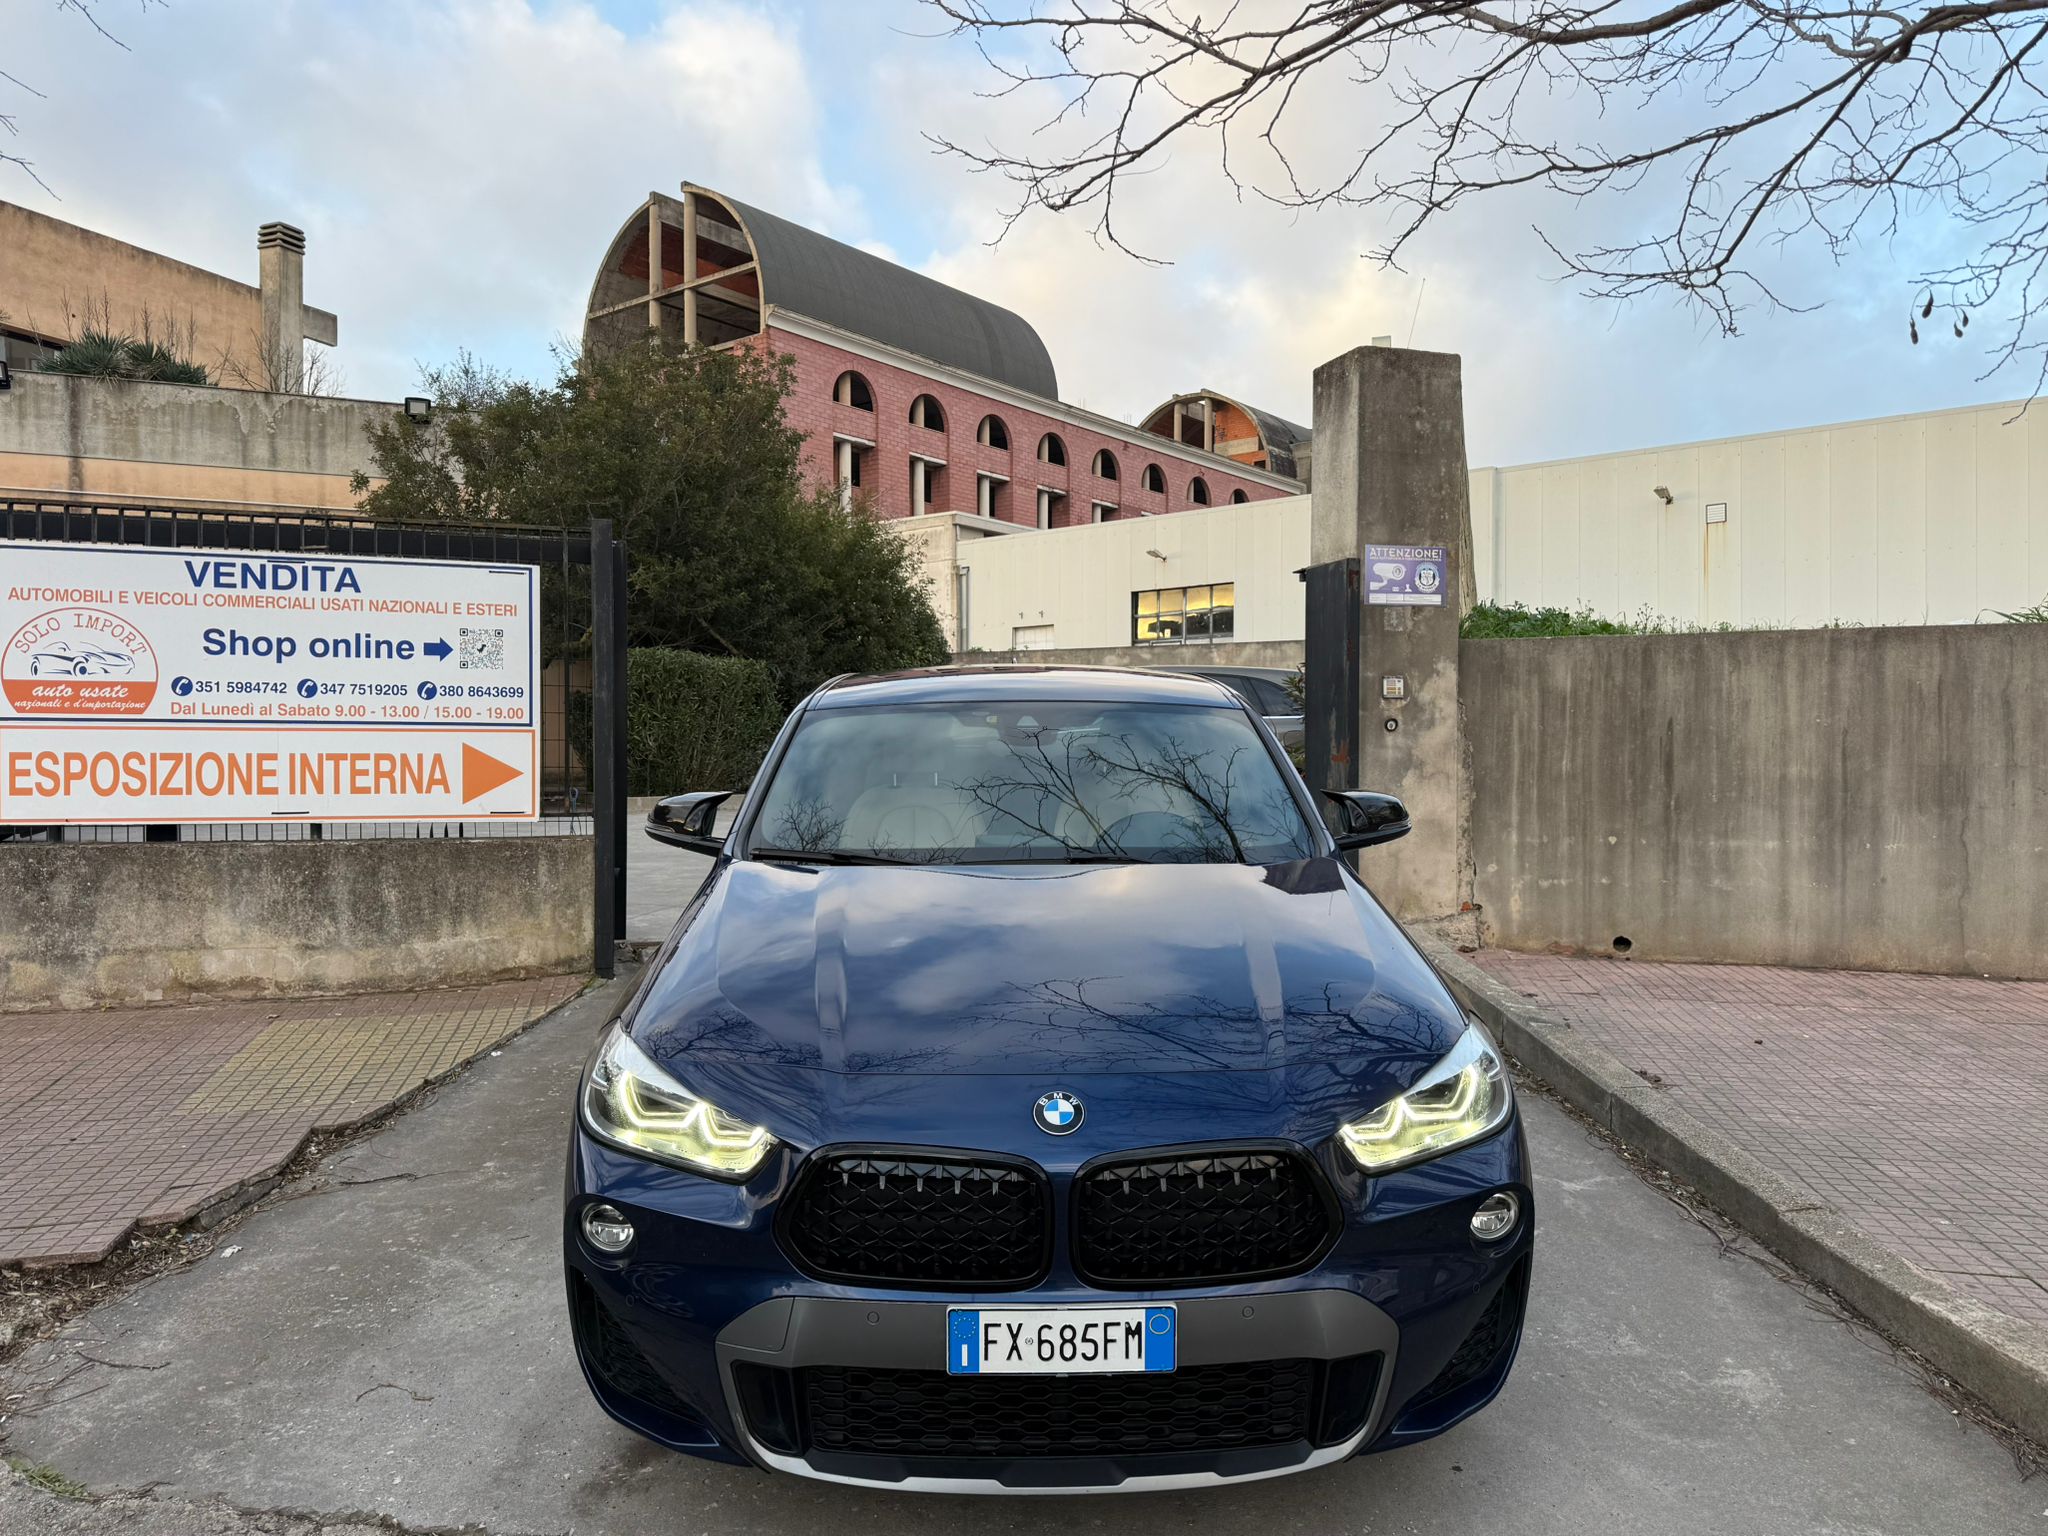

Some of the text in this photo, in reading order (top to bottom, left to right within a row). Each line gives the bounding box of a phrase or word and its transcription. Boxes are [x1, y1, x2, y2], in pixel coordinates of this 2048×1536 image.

[1370, 548, 1442, 558] ATTENZIONE!
[184, 560, 361, 593] VENDITA
[8, 588, 518, 617] AUTOMOBILI E VEICOLI COMMERCIALI USATI NAZIONALI E ESTERI
[15, 613, 147, 654] SOLO IMPORT
[203, 628, 415, 664] Shop online
[32, 684, 129, 698] auto usate
[195, 681, 287, 694] 351 5984742
[320, 683, 408, 696] 347 7519205
[440, 686, 524, 698] 380 8643699
[14, 699, 62, 710] nazionali
[74, 698, 146, 712] d'importazione
[170, 702, 196, 715] Dal
[202, 702, 254, 716] Lunedì
[260, 704, 272, 716] al
[278, 704, 330, 717] Sabato
[335, 705, 366, 718] 9.00
[381, 706, 419, 718] 13.00
[434, 706, 472, 719] 15.00
[486, 707, 524, 720] 19.00
[8, 751, 451, 797] ESPOSIZIONE INTERNA
[1038, 1092, 1079, 1106] BMW
